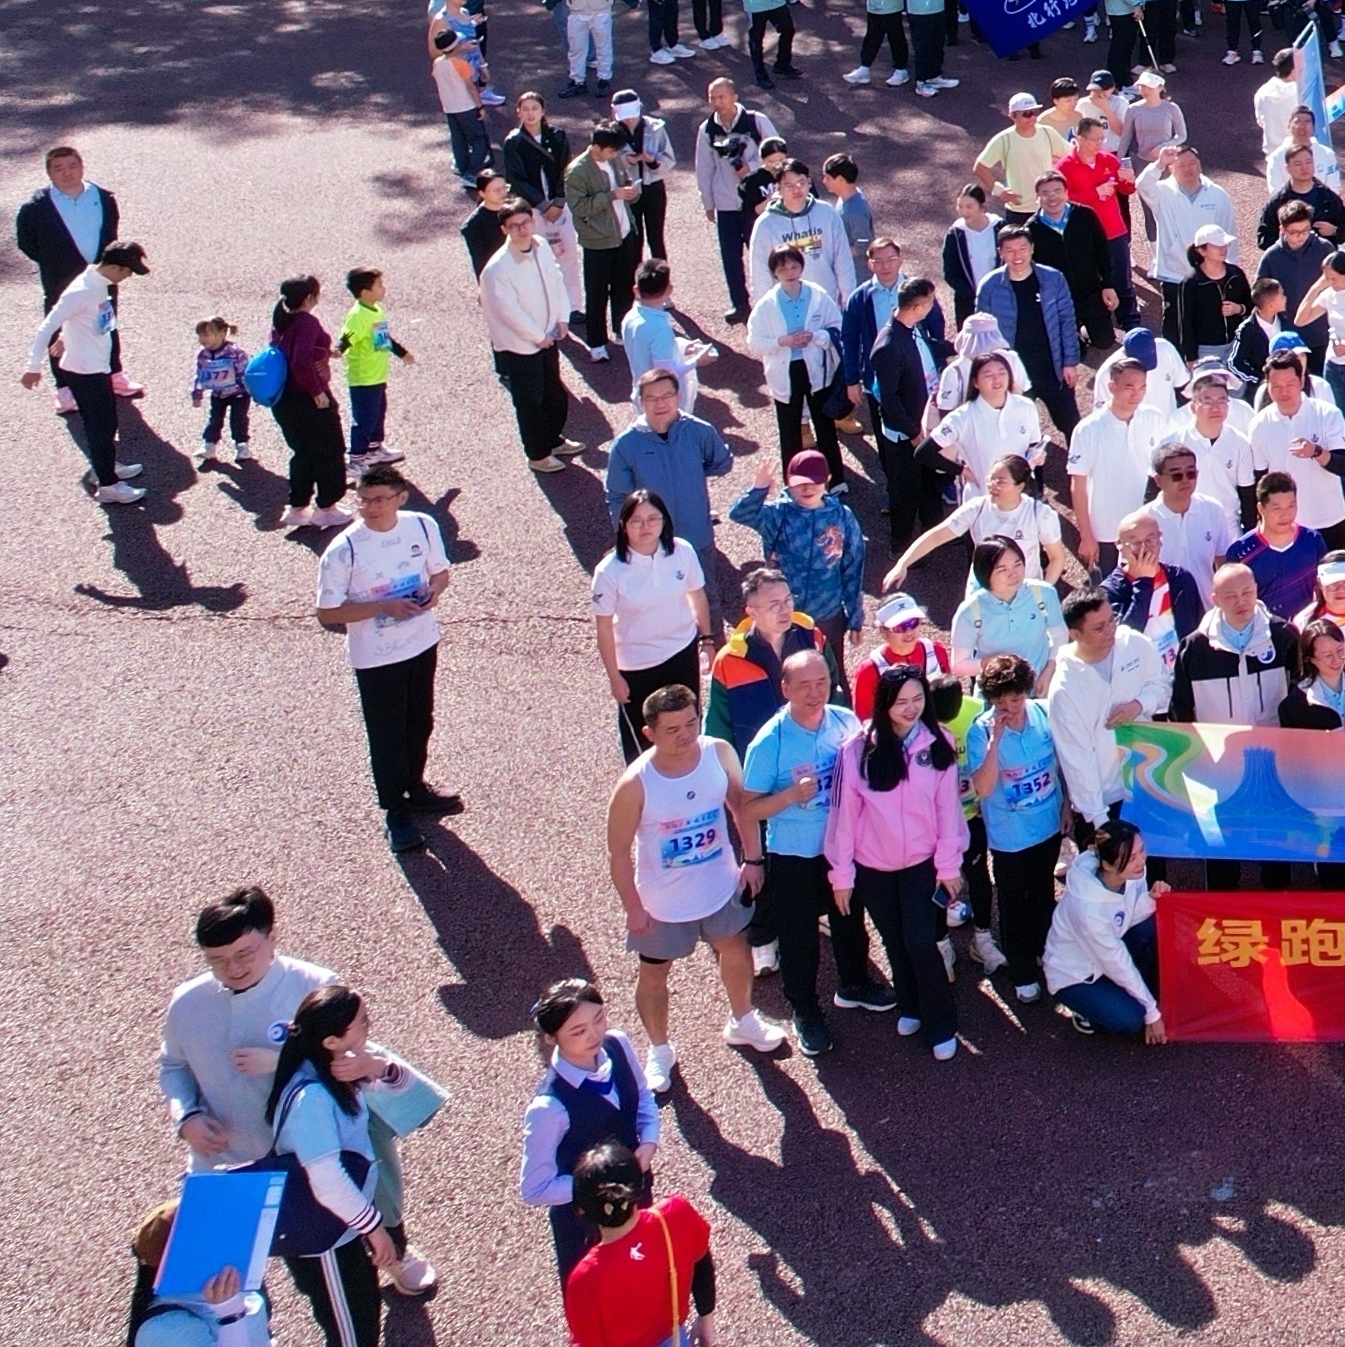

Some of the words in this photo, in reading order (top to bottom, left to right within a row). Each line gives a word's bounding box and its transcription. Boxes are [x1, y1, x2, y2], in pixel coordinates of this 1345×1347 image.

[201, 370, 229, 382] 1377
[1012, 773, 1050, 794] 1352
[670, 829, 716, 852] 1329
